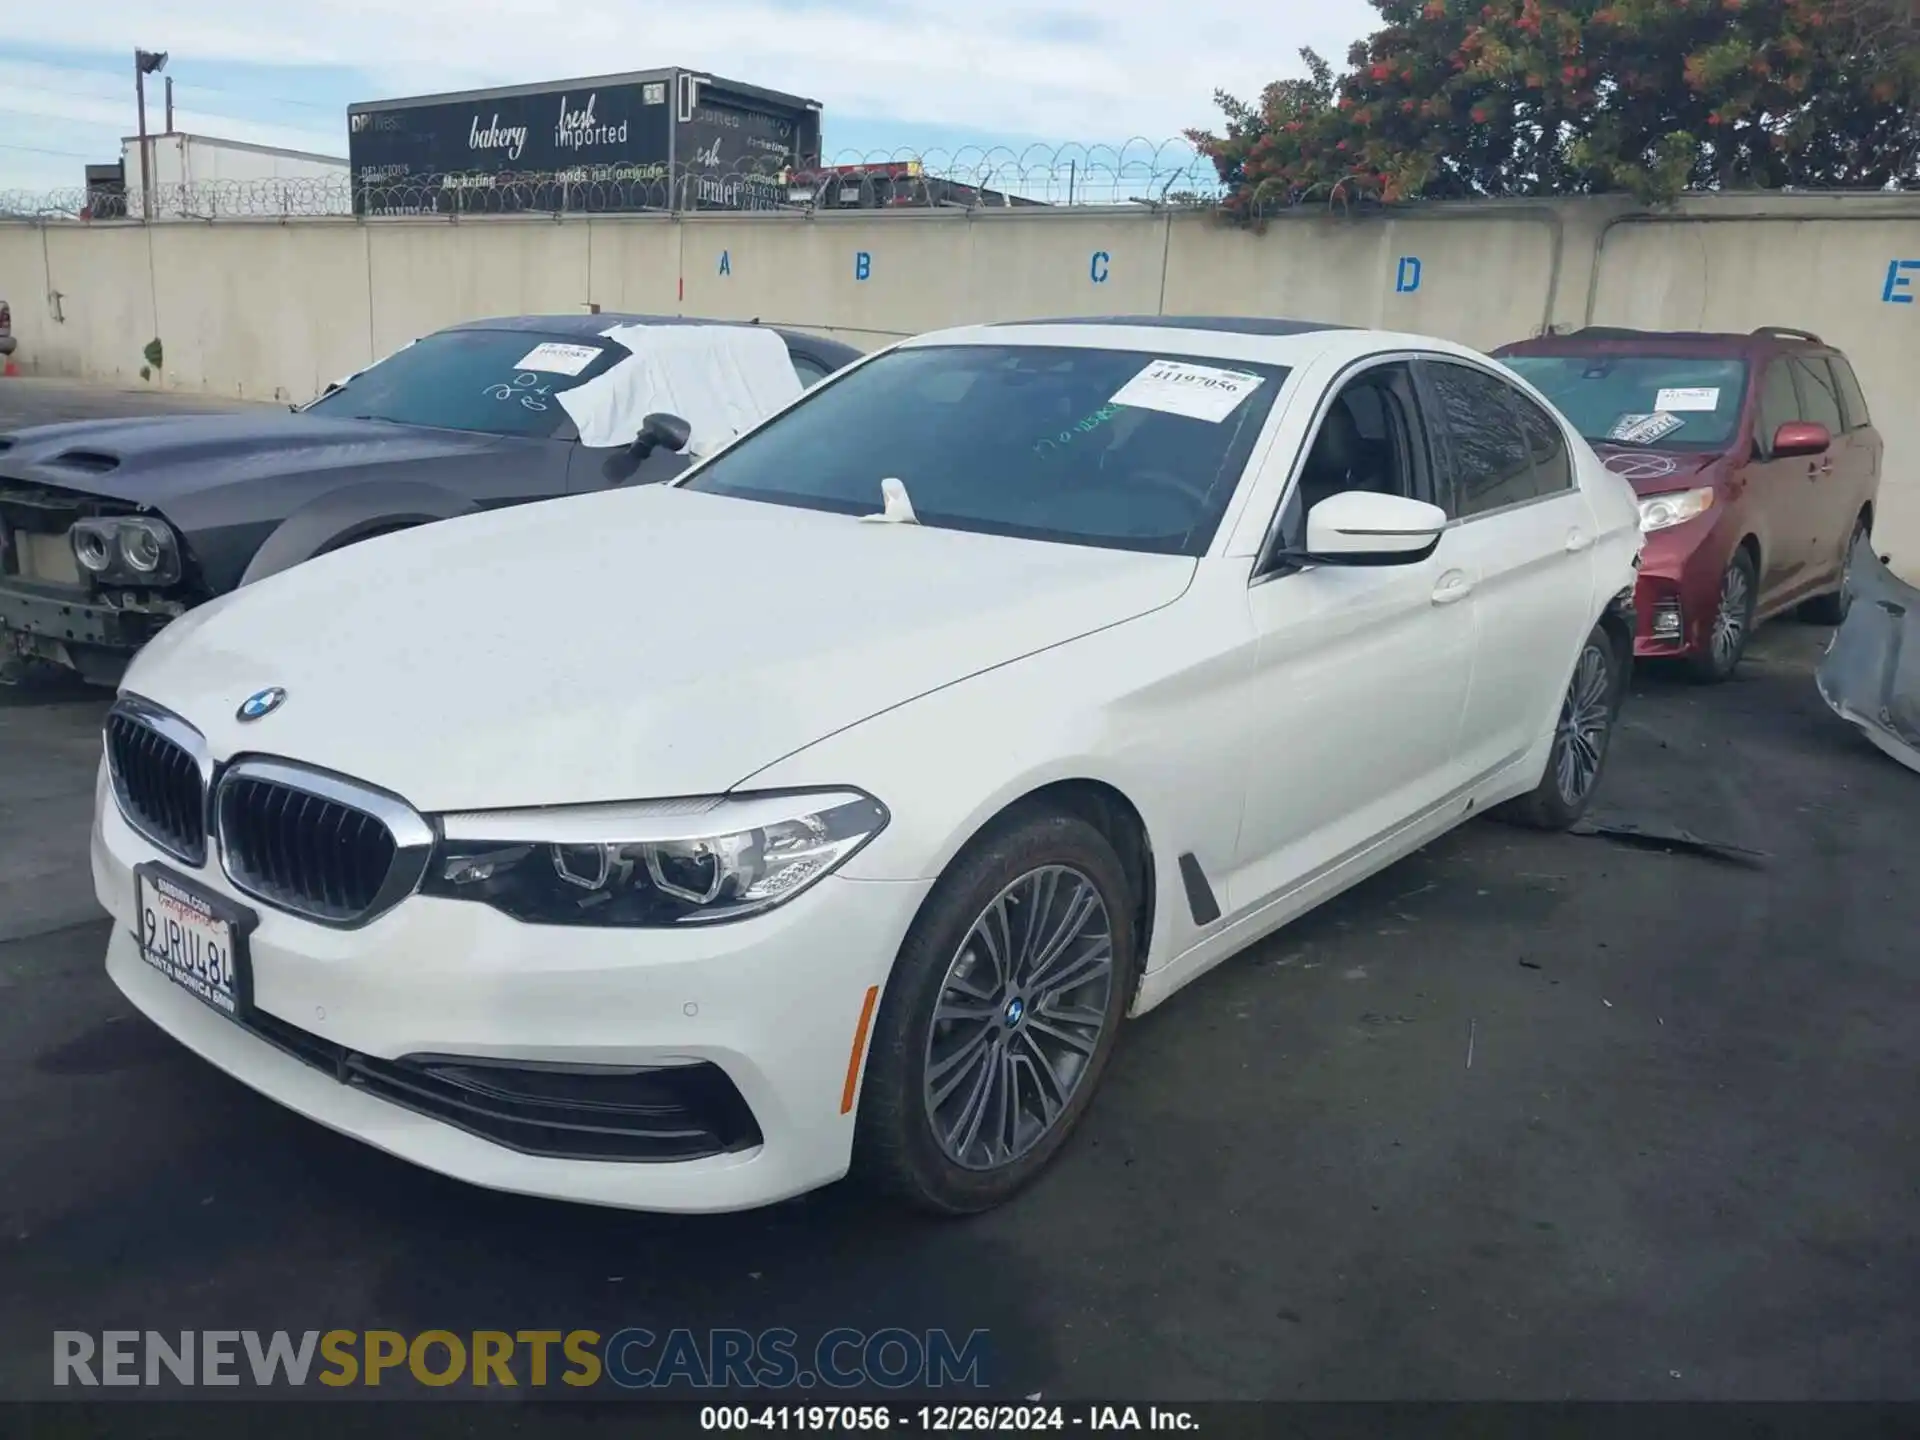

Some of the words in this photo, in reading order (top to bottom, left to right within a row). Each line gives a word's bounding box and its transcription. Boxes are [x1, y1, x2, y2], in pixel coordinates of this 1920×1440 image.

[469, 113, 527, 160] bakery
[554, 119, 627, 151] imported
[719, 250, 731, 276] A
[856, 252, 871, 280] B
[1091, 251, 1109, 282] C
[1396, 257, 1421, 293] D
[1883, 259, 1920, 303] E
